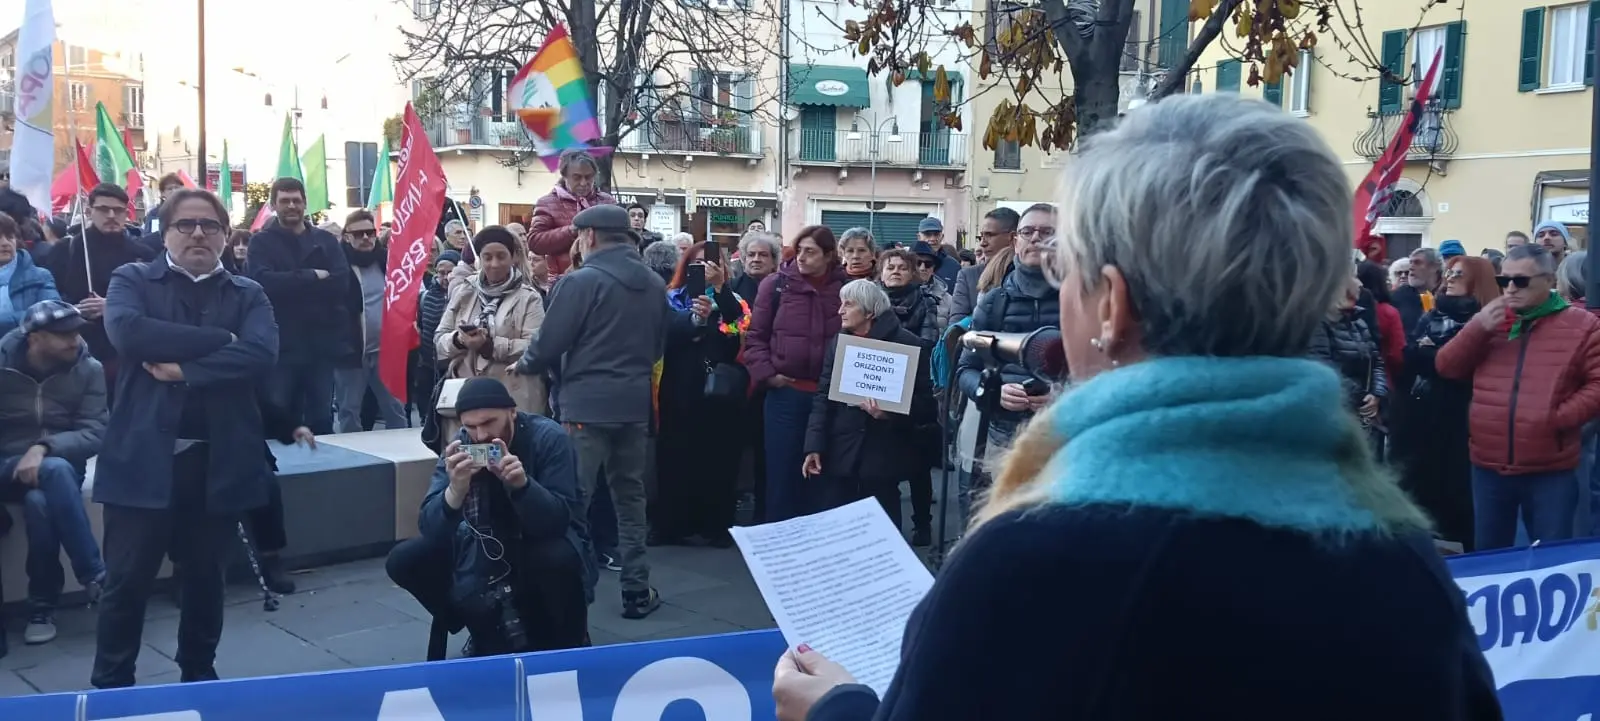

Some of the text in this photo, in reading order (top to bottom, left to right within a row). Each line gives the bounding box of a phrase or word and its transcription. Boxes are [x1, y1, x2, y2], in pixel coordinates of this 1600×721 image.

[723, 198, 755, 208] FERMO
[857, 352, 894, 363] ESISTONO
[854, 361, 894, 373] ORIZZONTI
[863, 374, 881, 382] NON
[856, 382, 886, 392] CONFINI
